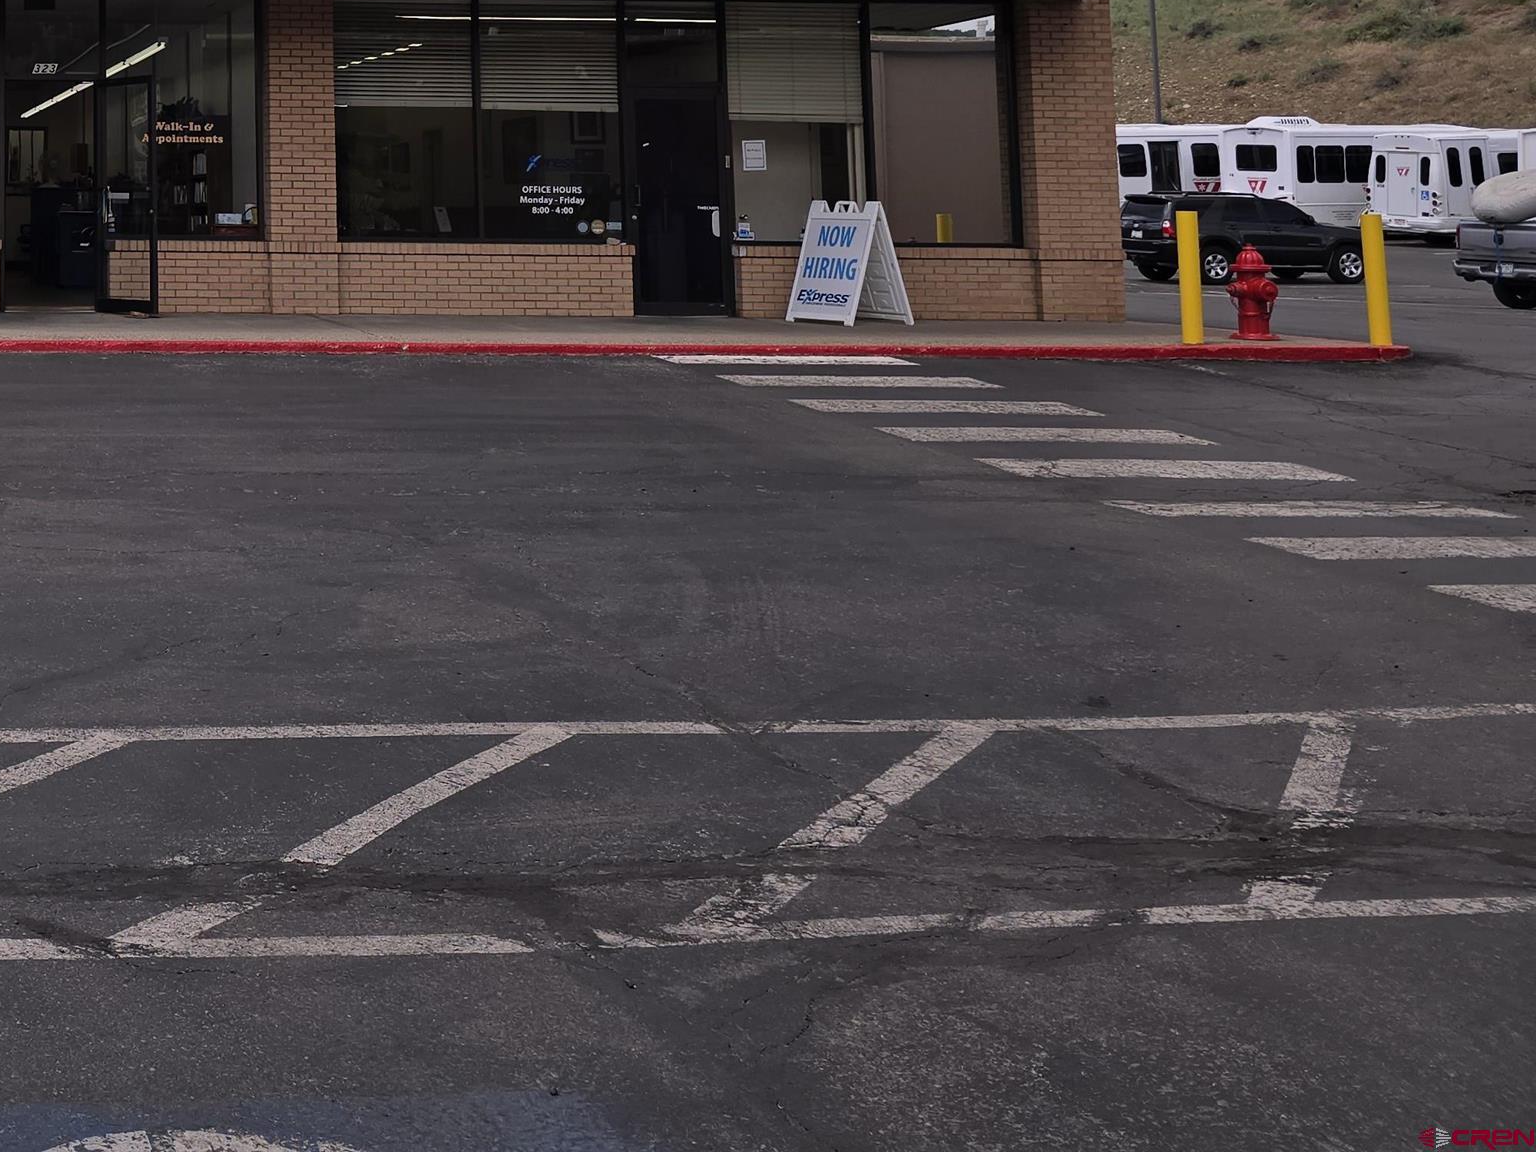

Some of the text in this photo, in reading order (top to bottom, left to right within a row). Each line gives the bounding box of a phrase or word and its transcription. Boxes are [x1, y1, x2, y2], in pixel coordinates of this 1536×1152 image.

[34, 64, 56, 73] 323
[204, 122, 214, 131] &
[522, 186, 582, 194] OFFICE HOURS
[520, 196, 553, 206] Monday
[560, 196, 585, 206] Friday
[818, 226, 856, 247] NOW
[802, 257, 858, 280] HIRING
[797, 289, 850, 304] Express
